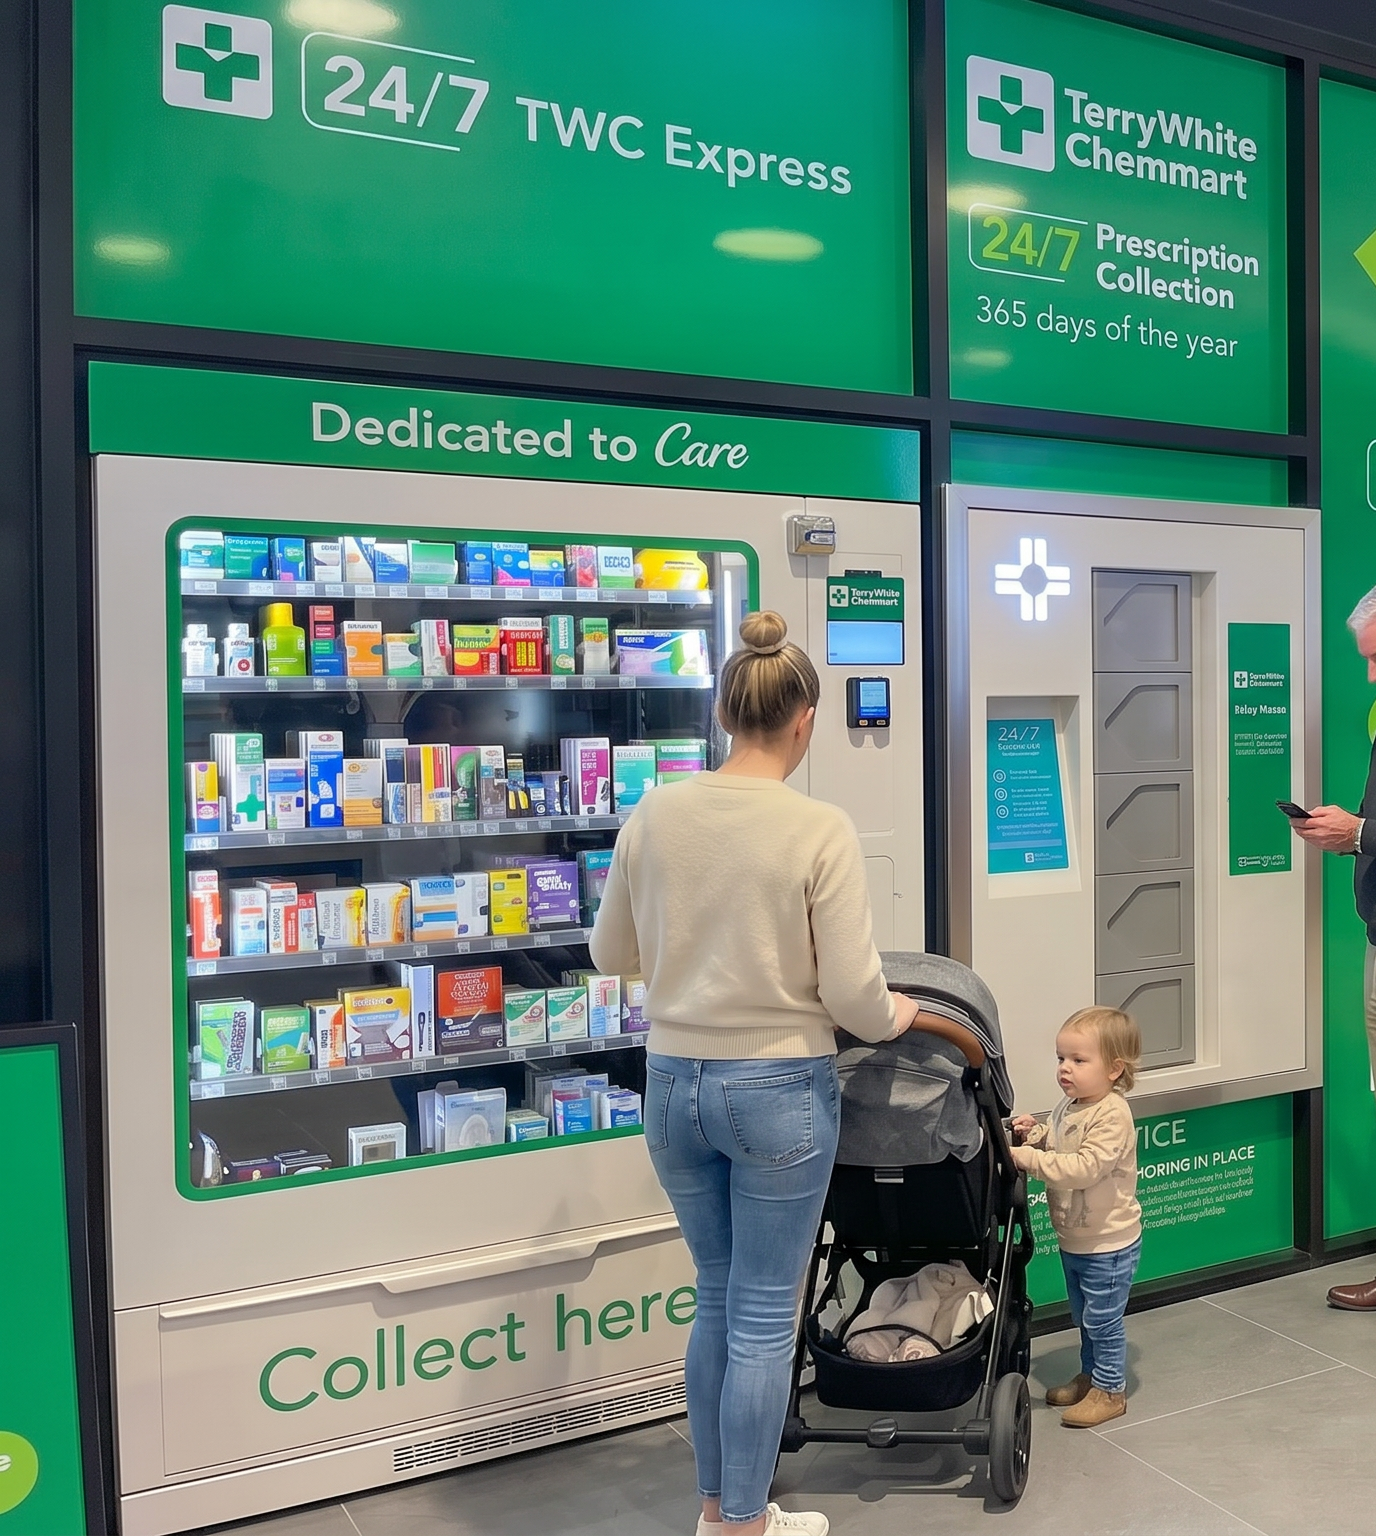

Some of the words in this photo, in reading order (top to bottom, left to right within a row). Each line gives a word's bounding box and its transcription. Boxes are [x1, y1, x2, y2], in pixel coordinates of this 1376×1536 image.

[324, 55, 490, 134] 24/7
[516, 97, 645, 160] TWC
[666, 124, 852, 195] Express
[1065, 88, 1257, 163] TerryWhite
[1065, 132, 1247, 200] Chemmart
[981, 215, 1080, 272] 24/7
[1097, 223, 1259, 277] Prescription
[1096, 262, 1234, 309] Collection
[977, 296, 1026, 328] 365
[1037, 304, 1096, 342] days
[1106, 315, 1131, 342] of
[1138, 319, 1178, 348] the
[1187, 334, 1238, 358] year
[313, 402, 572, 458] Dedicated
[589, 428, 637, 462] to
[655, 422, 749, 469] Care
[998, 727, 1040, 740] 24/7
[1194, 1154, 1208, 1169] IN
[1213, 1145, 1255, 1166] PLACE
[259, 1313, 526, 1412] Collect
[557, 1286, 698, 1351] here
